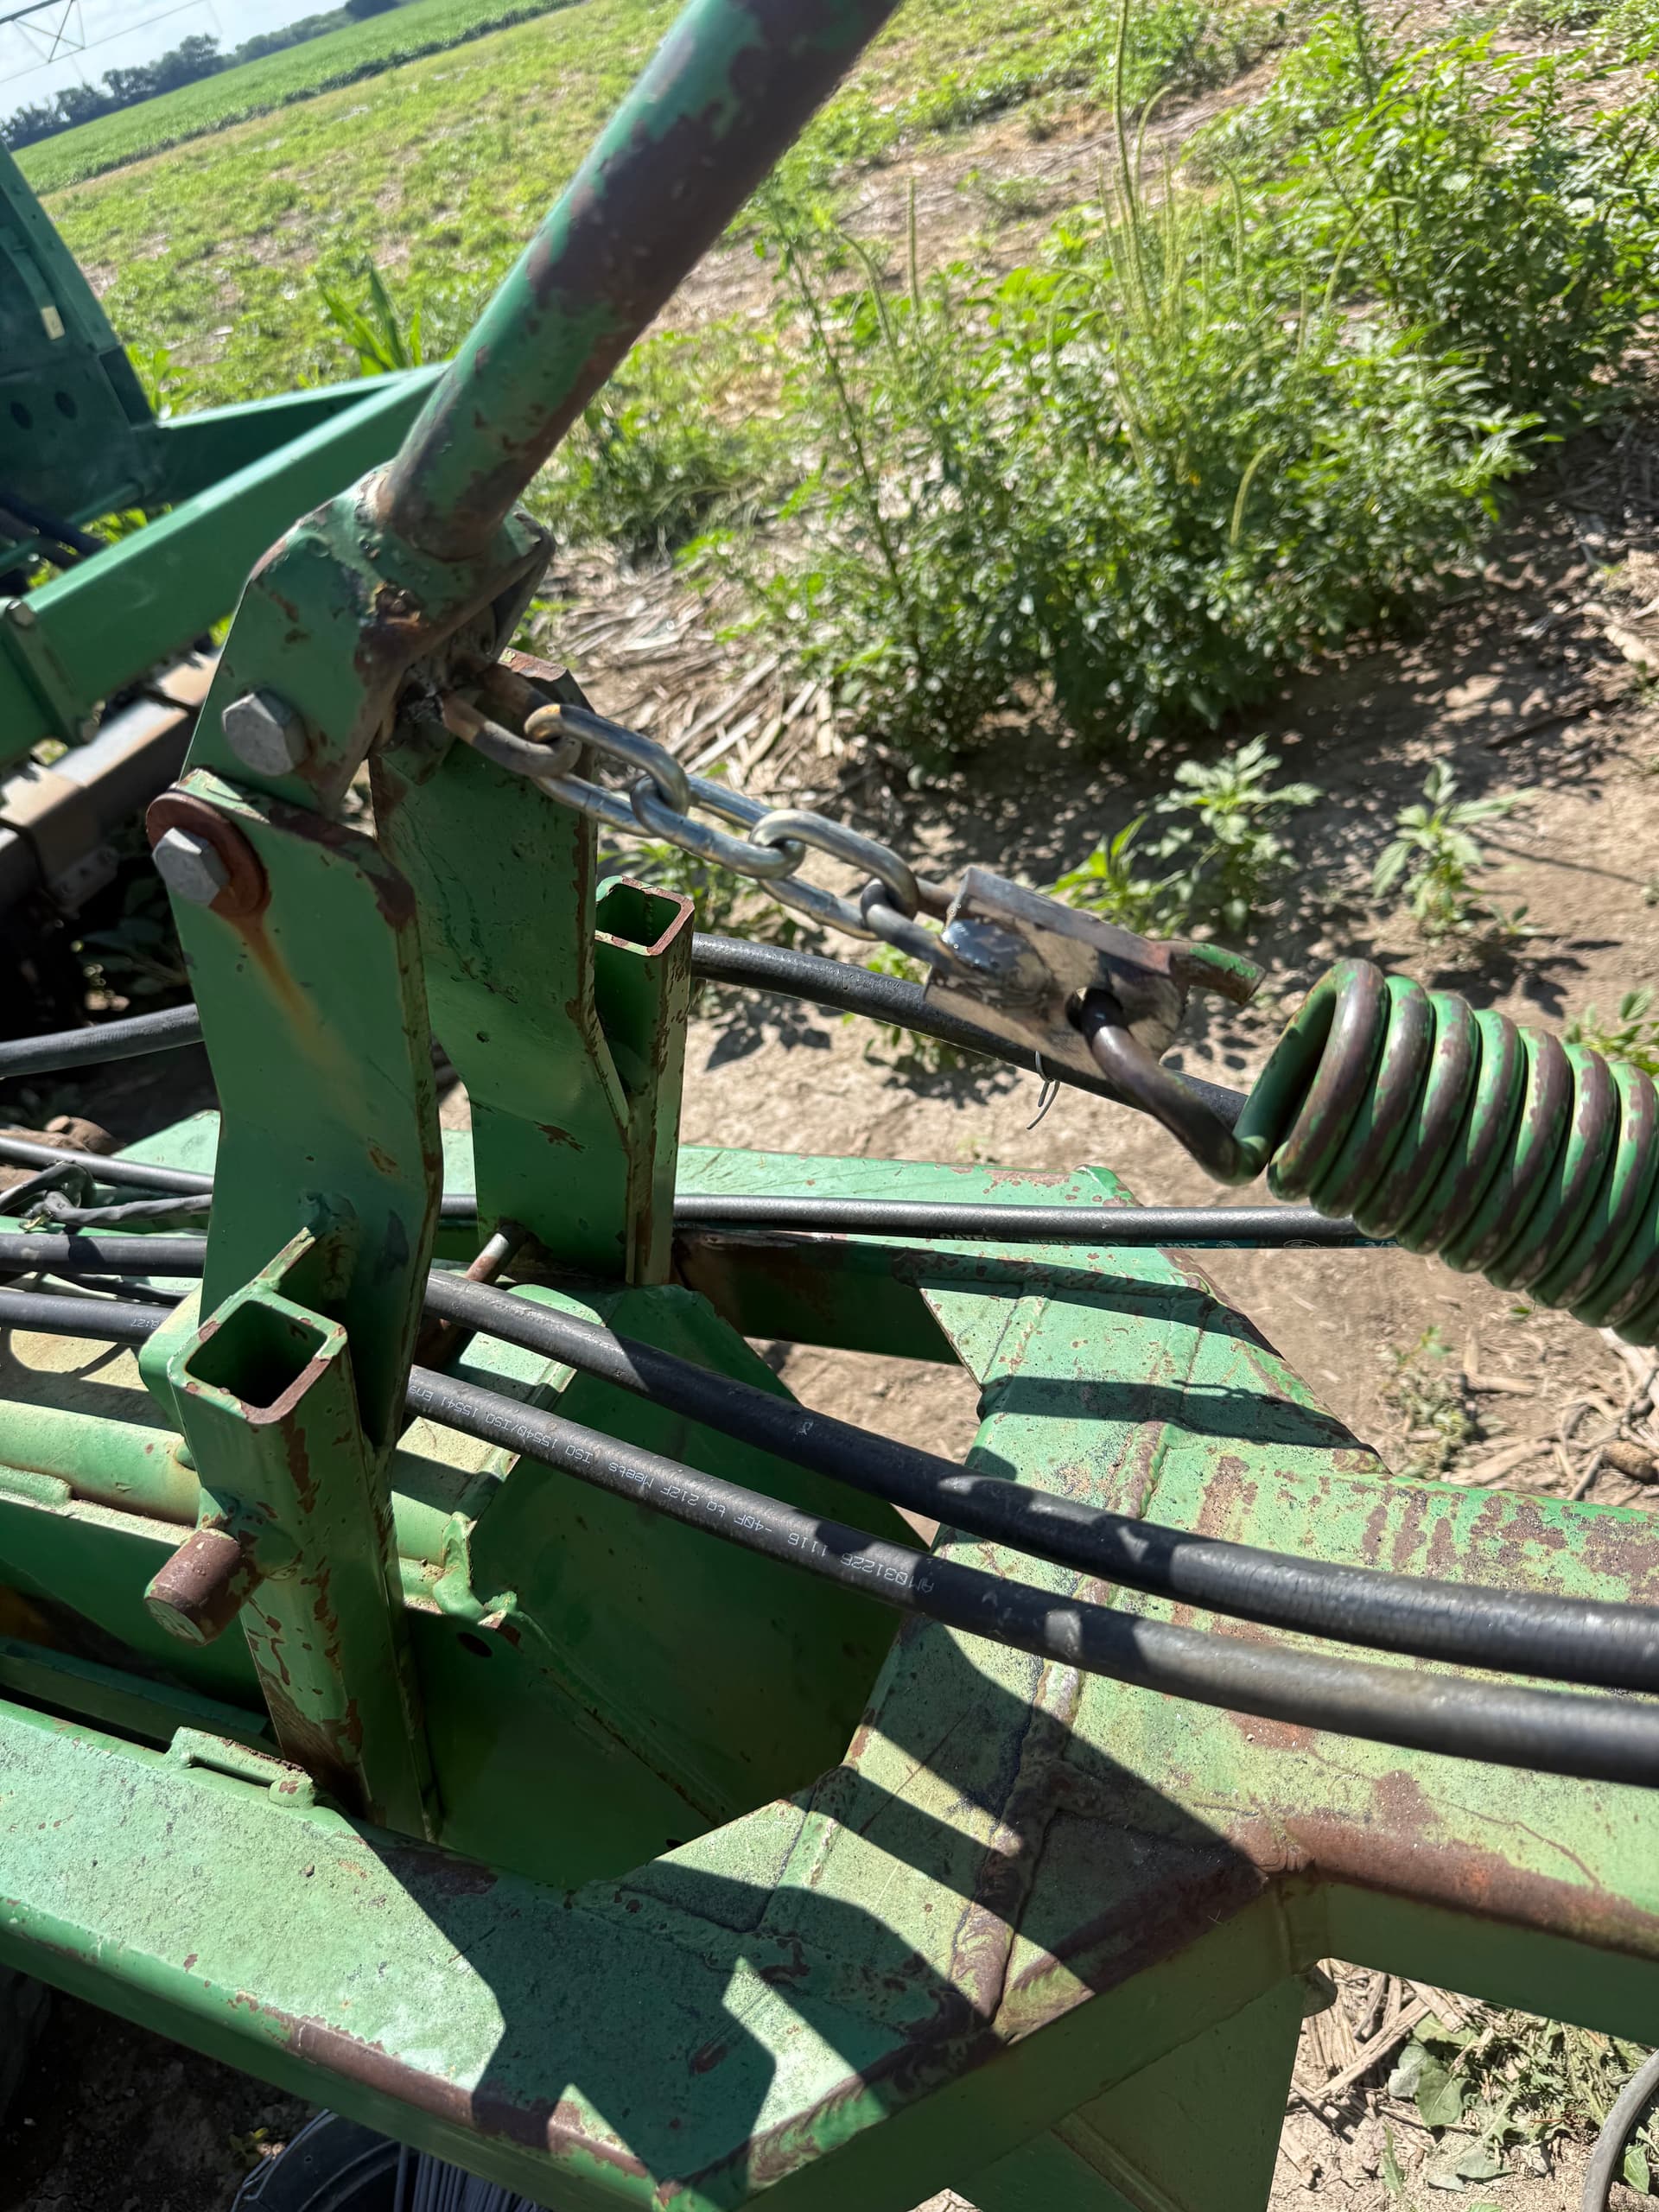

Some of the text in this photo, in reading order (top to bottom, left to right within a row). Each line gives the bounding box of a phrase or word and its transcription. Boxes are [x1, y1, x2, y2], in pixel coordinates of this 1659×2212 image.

[441, 1395, 479, 1418] 15541
[485, 1414, 558, 1449] 15540/ISO
[565, 1445, 594, 1465] ISO
[607, 1461, 655, 1489] Meets
[659, 1484, 700, 1506] 212F
[706, 1500, 727, 1517] to
[734, 1514, 772, 1533] -40F
[787, 1533, 830, 1557] 1116
[840, 1553, 935, 1593] AM031226
